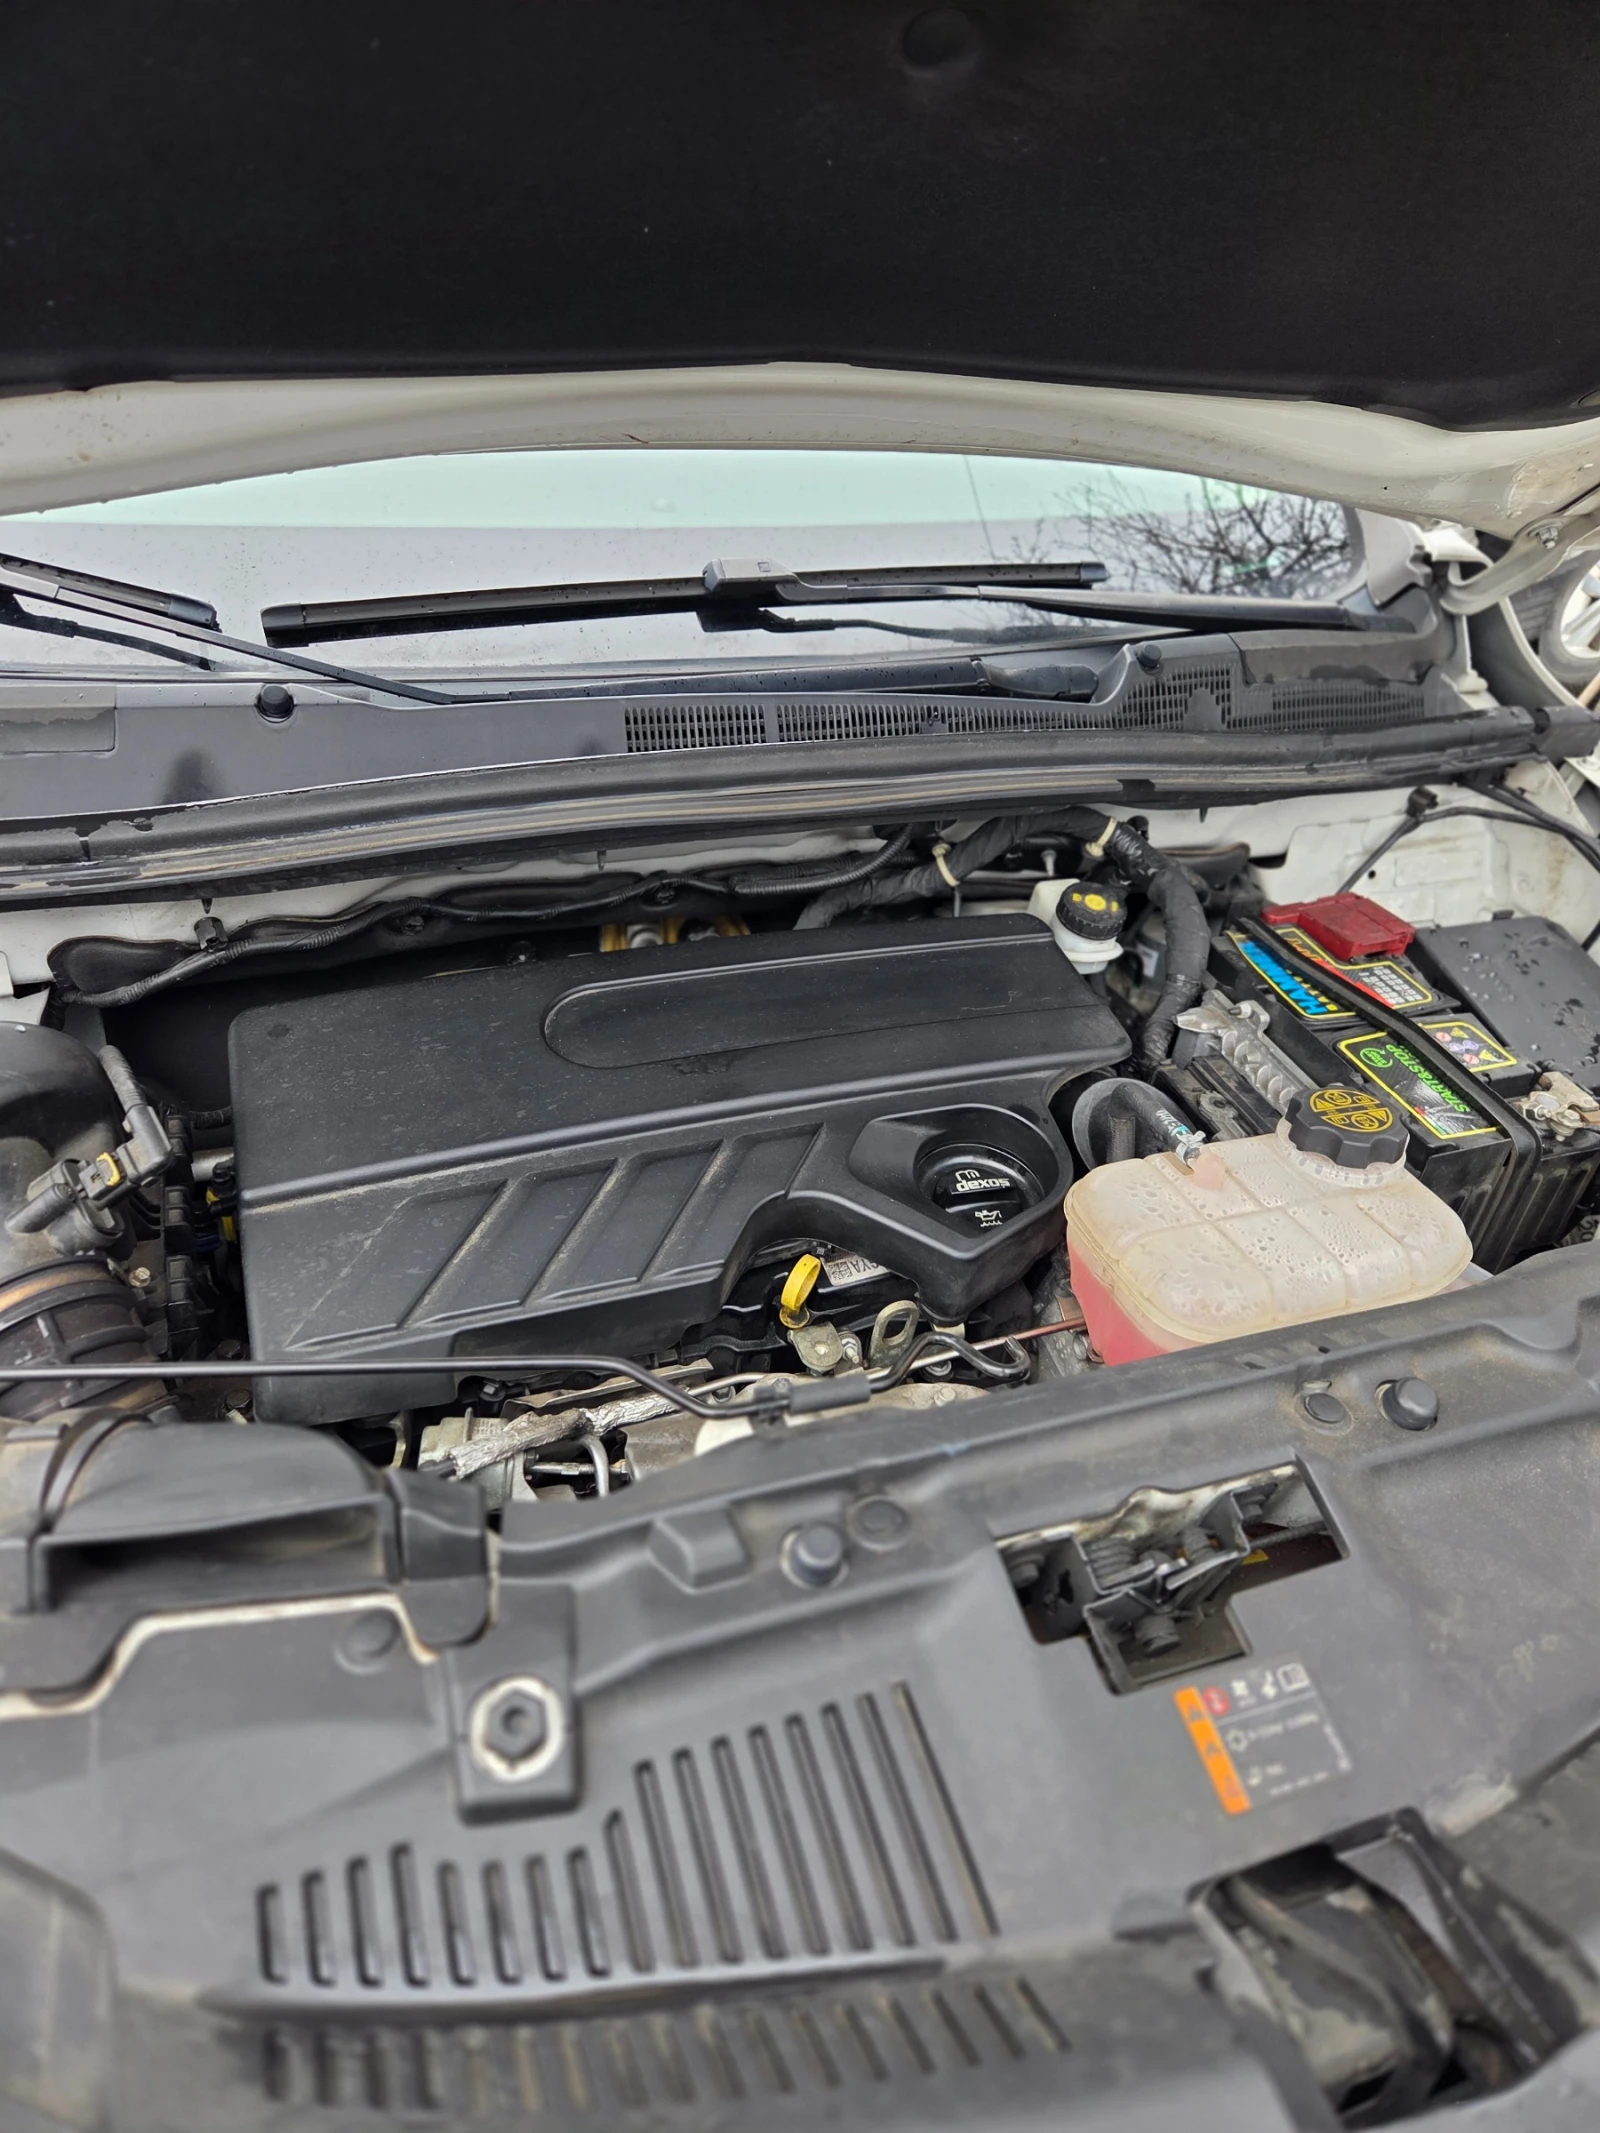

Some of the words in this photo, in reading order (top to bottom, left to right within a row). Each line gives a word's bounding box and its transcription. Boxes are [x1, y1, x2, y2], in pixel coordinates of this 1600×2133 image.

[1239, 941, 1328, 1014] HAMMER
[1386, 1044, 1471, 1112] START&STOP
[956, 1179, 1011, 1192] dexos
